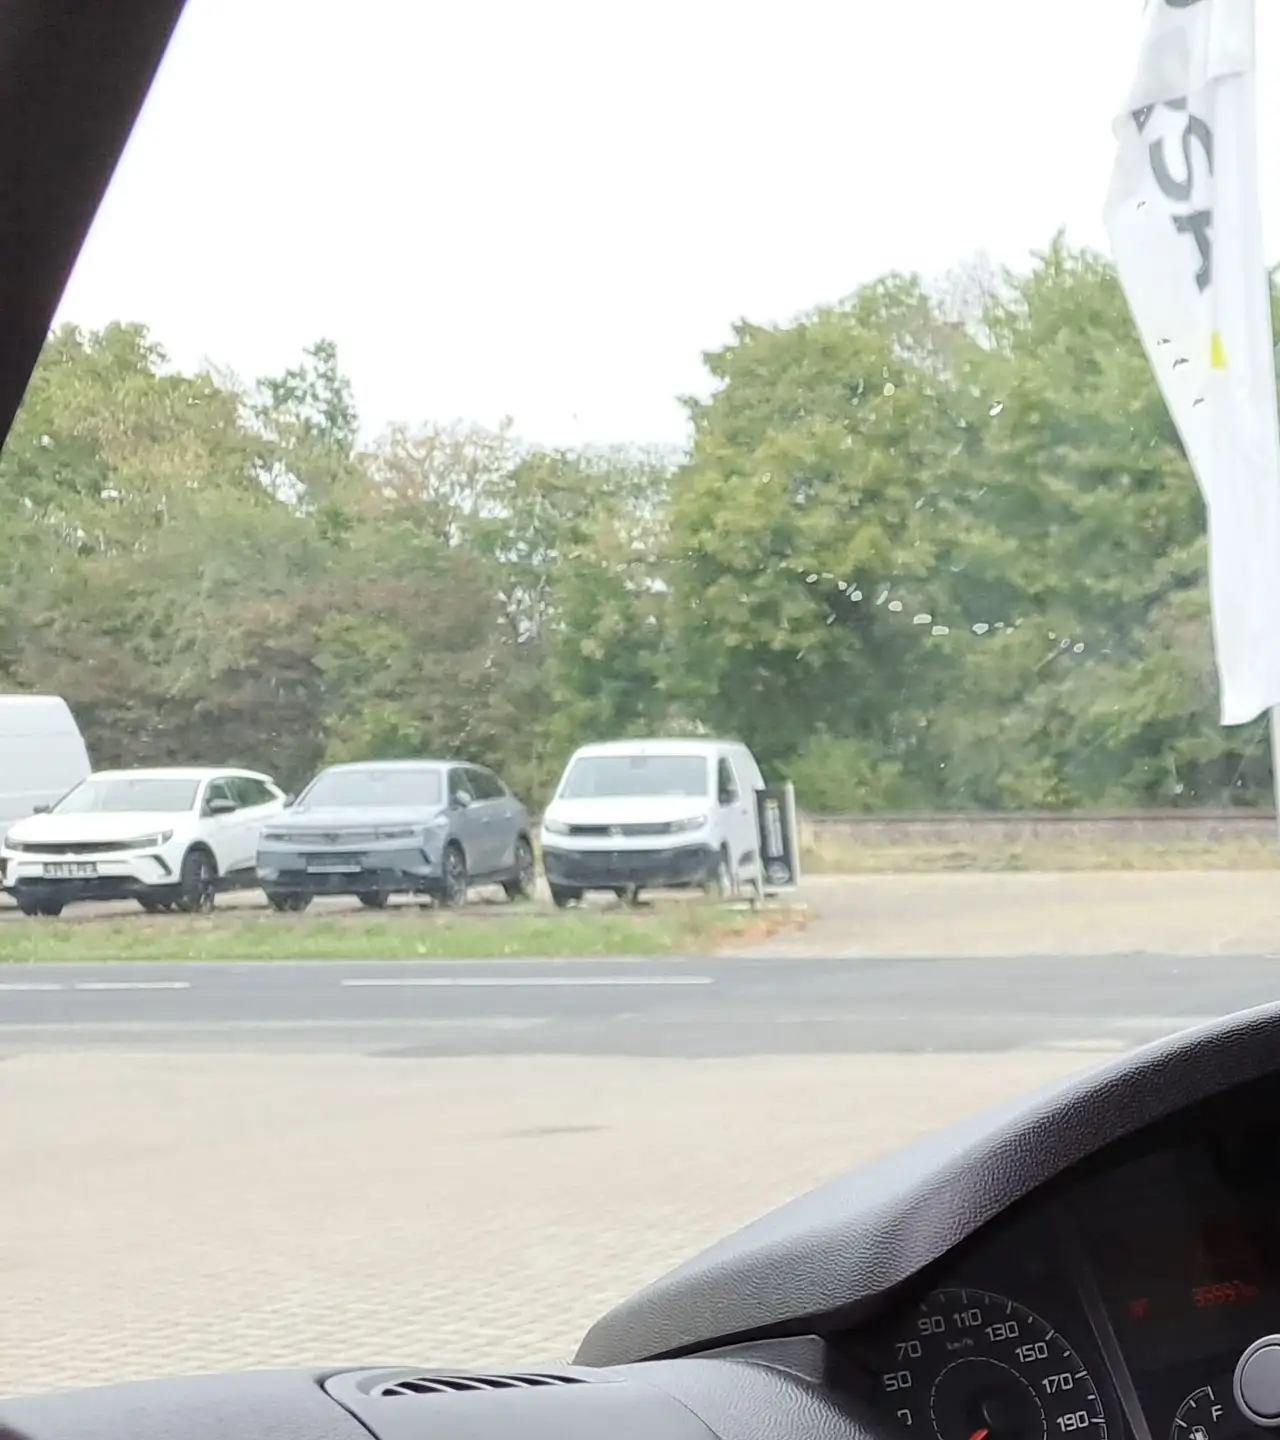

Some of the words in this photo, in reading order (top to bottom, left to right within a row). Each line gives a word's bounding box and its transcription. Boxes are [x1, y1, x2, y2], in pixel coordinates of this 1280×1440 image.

[917, 1315, 945, 1336] 90
[953, 1309, 982, 1328] 110
[985, 1321, 1019, 1342] 130
[895, 1340, 921, 1360] 70
[1015, 1342, 1048, 1363] 150
[883, 1370, 912, 1391] 50
[1042, 1373, 1074, 1394] 170
[1056, 1411, 1089, 1432] 190
[1211, 1404, 1224, 1422] F
